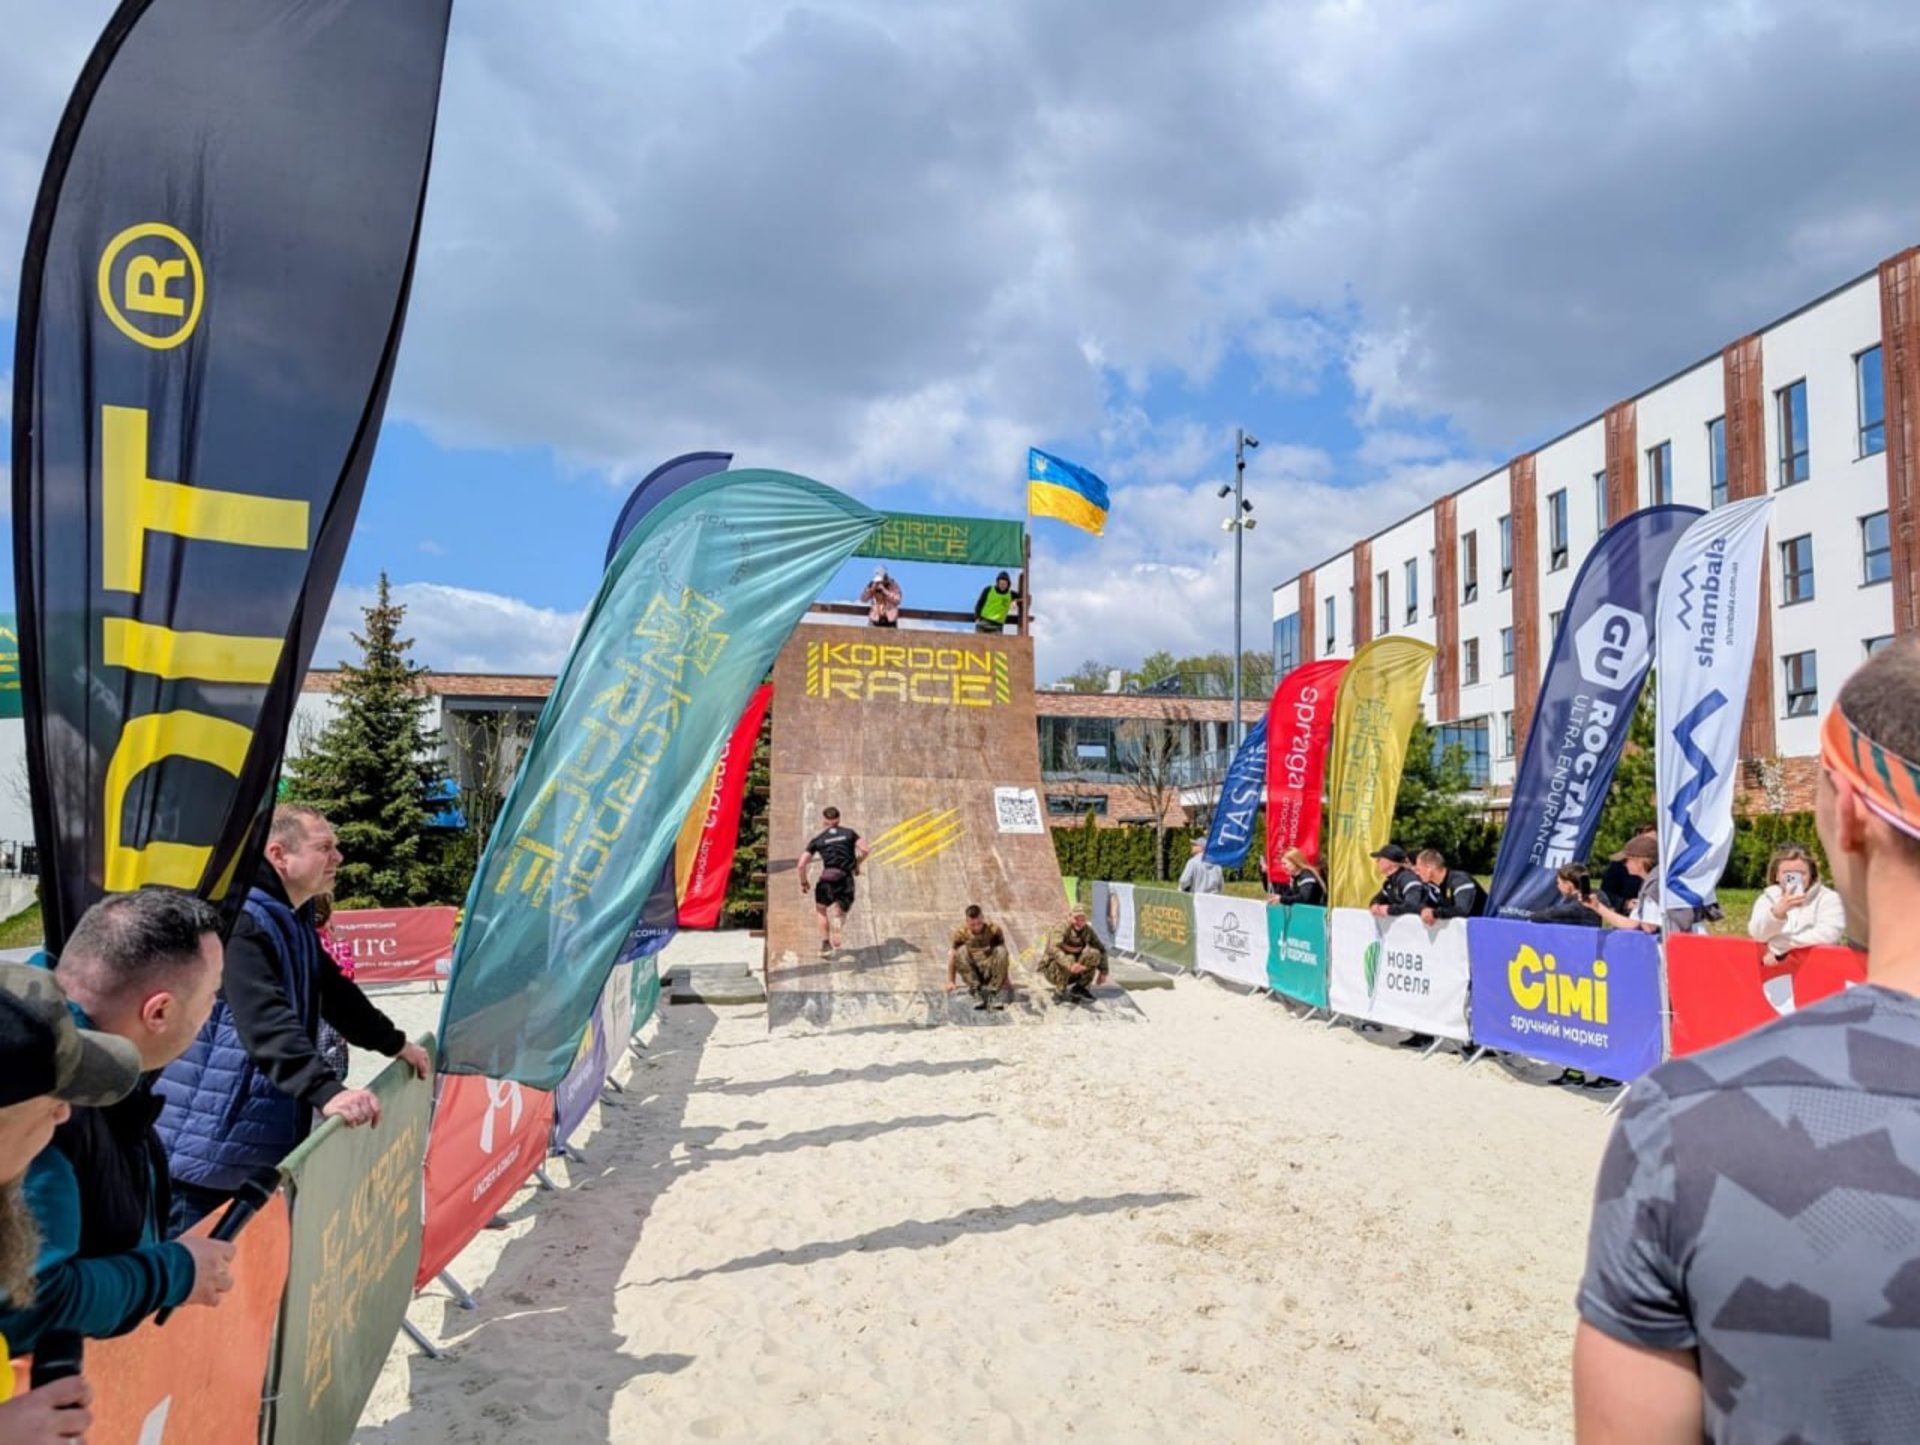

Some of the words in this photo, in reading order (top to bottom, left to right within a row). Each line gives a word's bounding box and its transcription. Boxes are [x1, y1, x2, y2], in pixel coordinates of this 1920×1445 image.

[879, 534, 969, 558] RACE
[1694, 537, 1727, 668] shambala
[1726, 562, 1739, 646] shambala.com.ua
[822, 642, 991, 672] KORDON
[1594, 614, 1631, 681] GU
[822, 667, 992, 707] RACE
[1284, 686, 1319, 790] spraga
[1562, 694, 1590, 750] ULTRA
[1529, 757, 1573, 866] ENDURANCE
[1544, 699, 1617, 869] ROCTANE
[1386, 971, 1430, 996] оселя
[1387, 951, 1424, 971] нова
[1508, 944, 1609, 1025] Сімі
[1510, 1014, 1560, 1039] зручний
[1563, 1028, 1609, 1048] маркет
